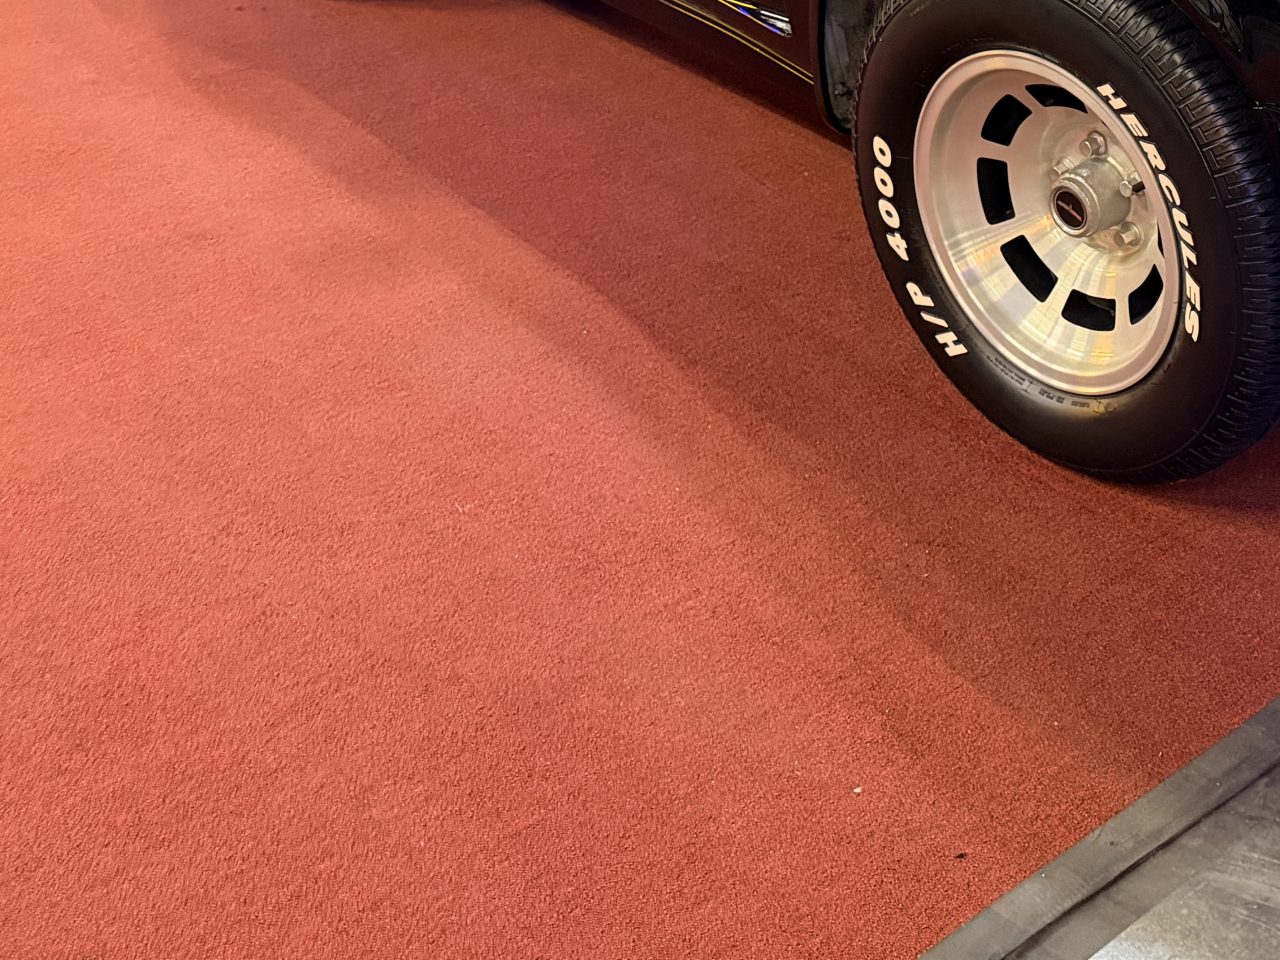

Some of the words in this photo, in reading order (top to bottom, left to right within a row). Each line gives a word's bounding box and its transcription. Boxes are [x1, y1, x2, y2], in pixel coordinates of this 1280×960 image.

[872, 135, 909, 262] 4000
[1096, 82, 1201, 342] HERCULES
[905, 281, 968, 358] H/P
